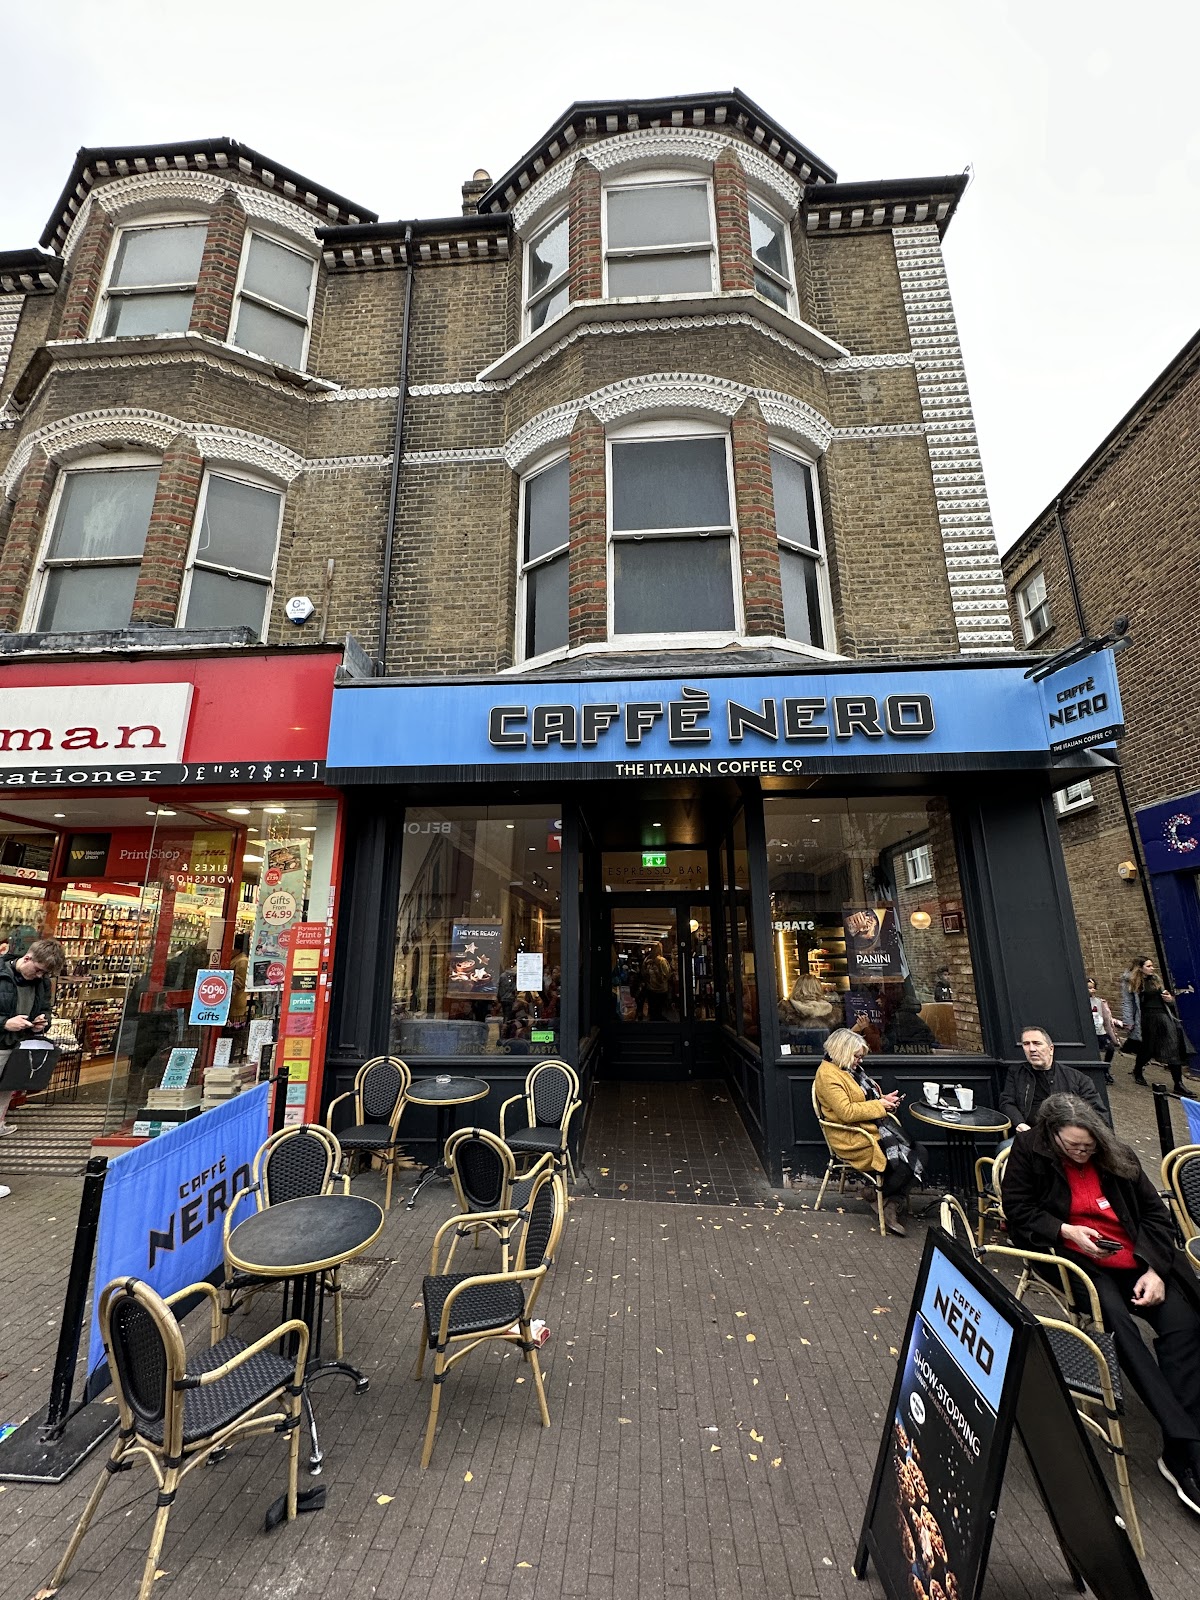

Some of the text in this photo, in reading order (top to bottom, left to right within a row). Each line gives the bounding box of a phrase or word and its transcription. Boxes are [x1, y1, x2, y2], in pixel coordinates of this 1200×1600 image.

[1056, 676, 1096, 703] CAFFÈ
[488, 685, 938, 748] CAFFÈ NERO
[1048, 692, 1109, 730] NERO
[1063, 738, 1083, 749] ITALIAN
[1083, 732, 1103, 743] COFFEE
[0, 768, 161, 785] ationer
[615, 763, 644, 776] THE
[649, 762, 711, 775] ITALIAN
[716, 761, 777, 774] COFFEE
[119, 849, 180, 860] Print Shop
[608, 866, 703, 876] ESPRESSO BAR
[270, 896, 291, 905] Gifts
[265, 910, 292, 919] £4.99
[856, 953, 891, 964] PANINI
[201, 985, 225, 995] 50%
[197, 1011, 220, 1021] Gifts
[529, 1044, 559, 1054] PASTA
[788, 1044, 813, 1053] ATTE
[179, 1155, 226, 1199] CAFFÈ
[148, 1162, 251, 1270] NERO
[953, 1288, 982, 1326] CAFFÈ
[933, 1284, 995, 1376] NERO
[913, 1348, 981, 1457] SHOW-STOPPING
